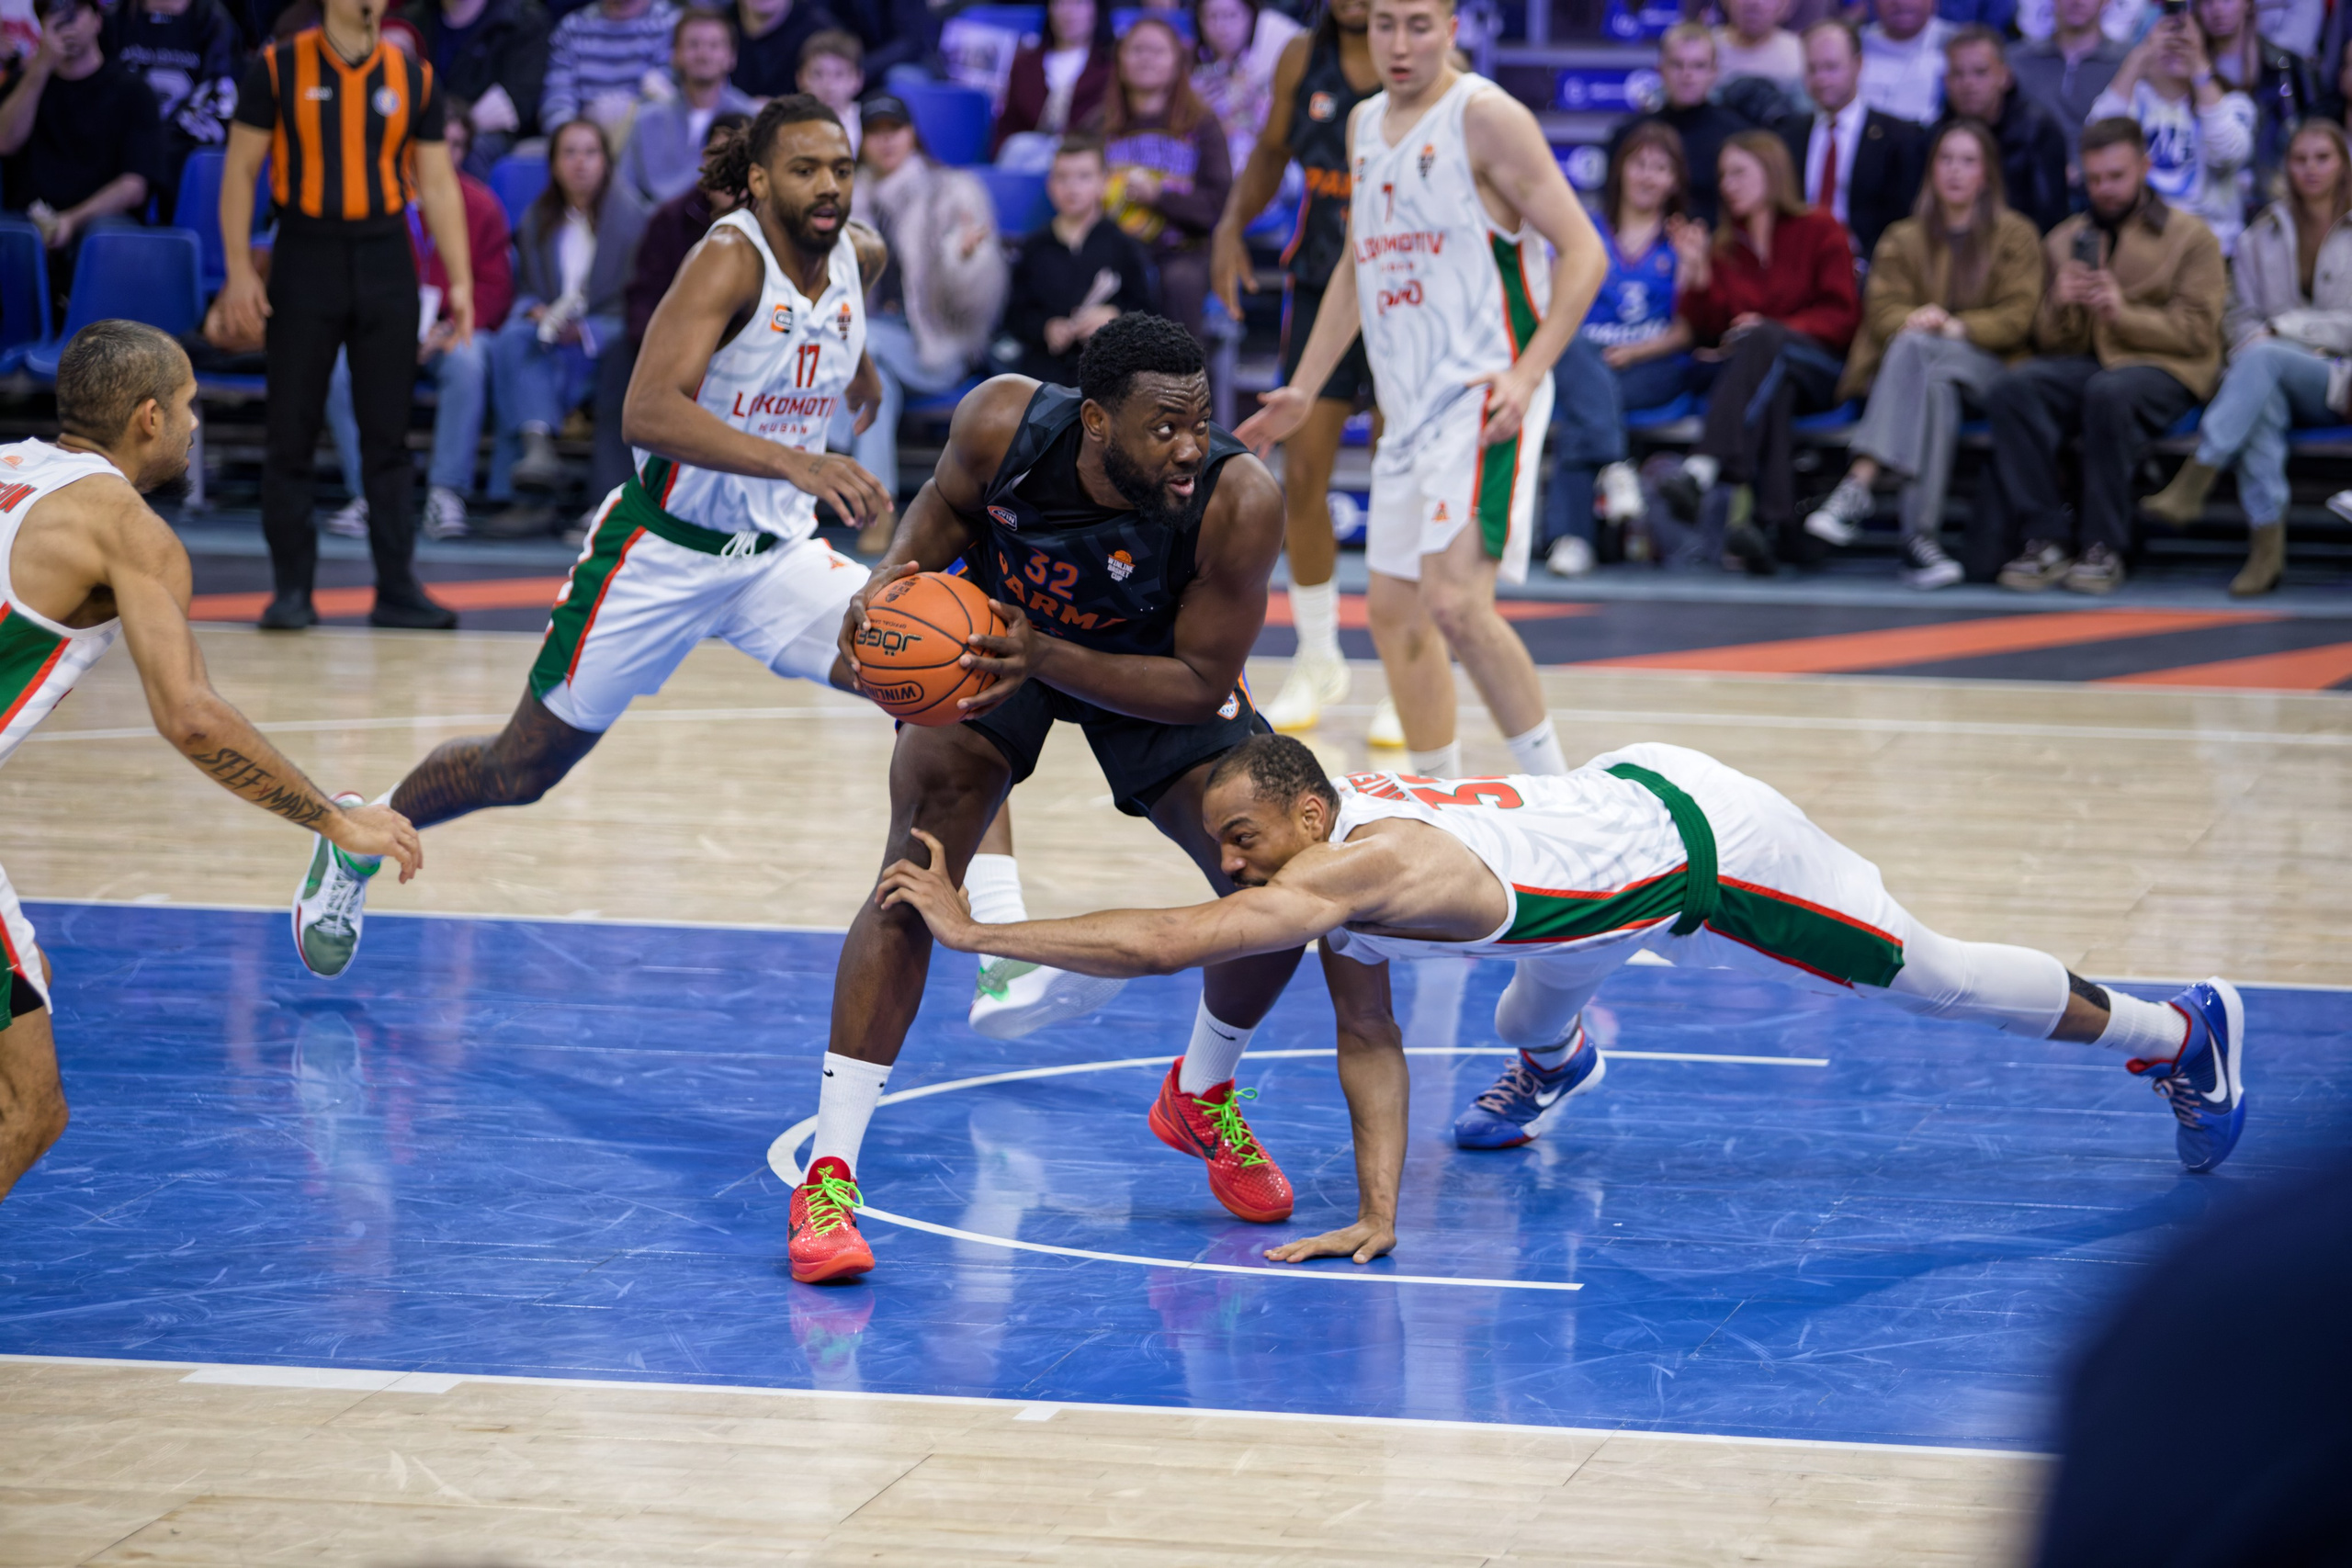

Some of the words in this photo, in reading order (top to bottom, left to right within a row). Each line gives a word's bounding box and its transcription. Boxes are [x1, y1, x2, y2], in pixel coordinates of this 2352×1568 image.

[1382, 182, 1395, 223] 7
[797, 344, 820, 389] 17
[732, 392, 838, 418] LKOMOTI
[997, 510, 1015, 525] WIN
[1024, 547, 1080, 600] 32
[1108, 558, 1134, 572] WINLINE
[1111, 572, 1123, 581] CUP
[999, 550, 1128, 630] ARM
[855, 627, 923, 656] JÖGE
[864, 684, 917, 702] WINLIN
[1396, 773, 1524, 811] 3
